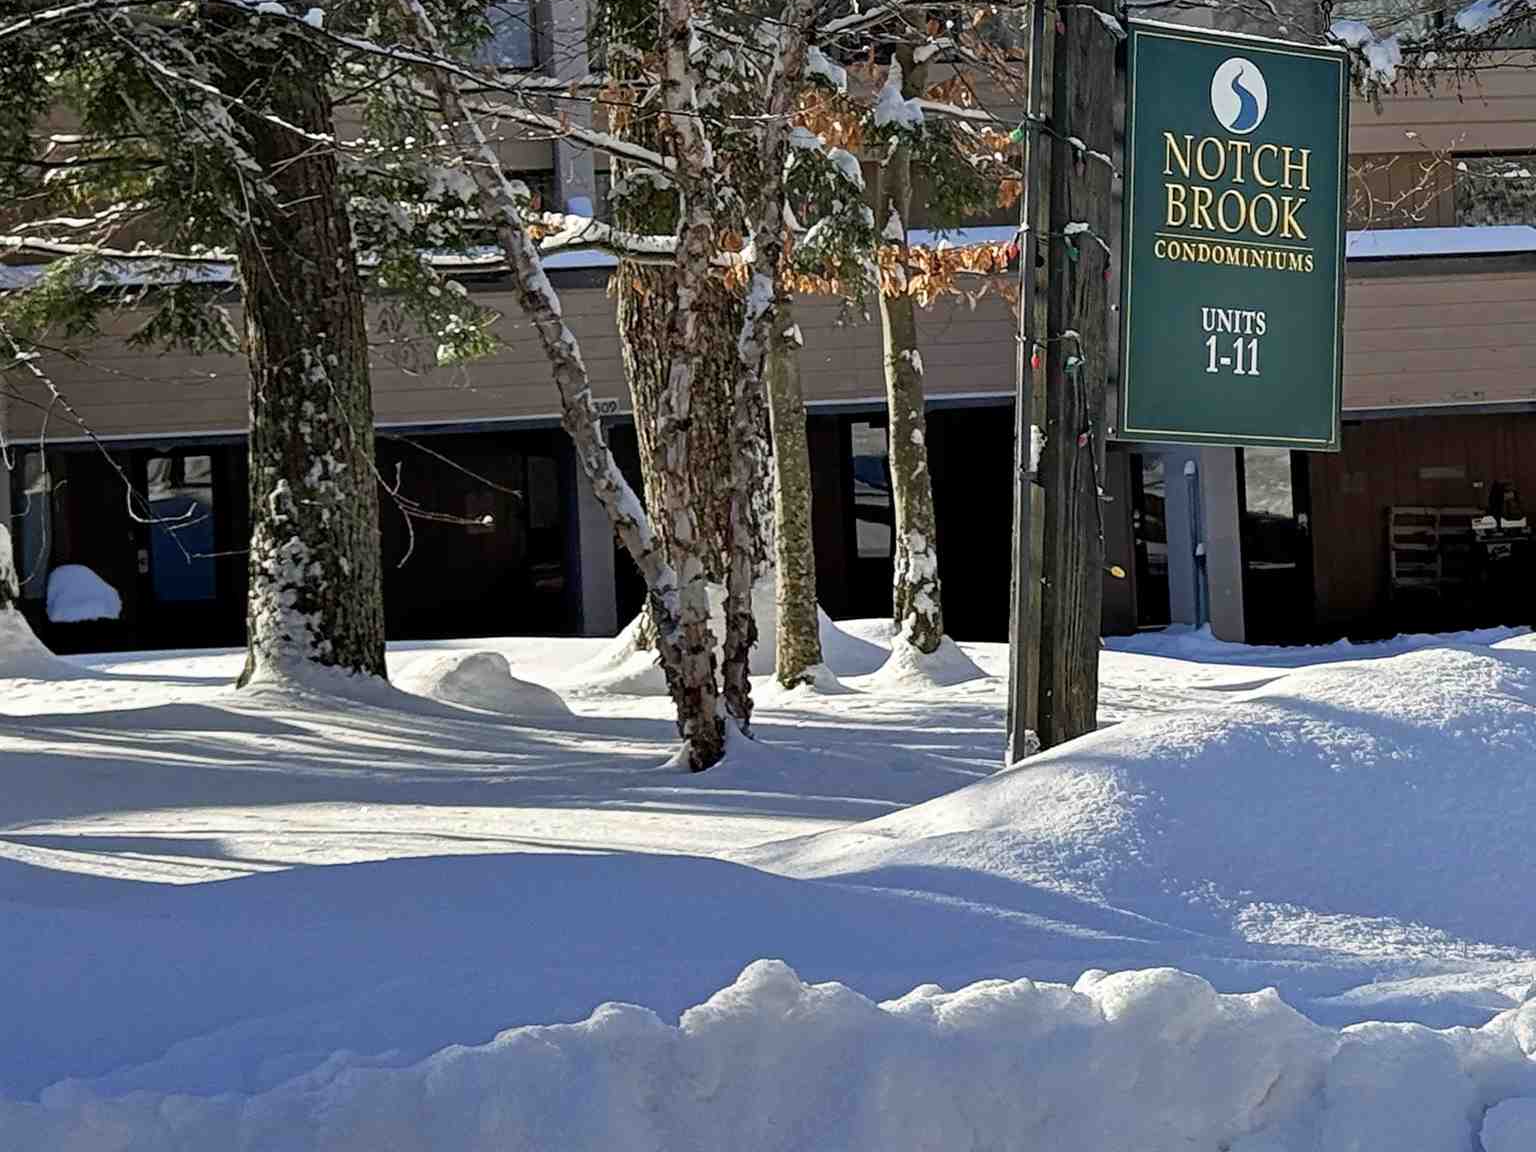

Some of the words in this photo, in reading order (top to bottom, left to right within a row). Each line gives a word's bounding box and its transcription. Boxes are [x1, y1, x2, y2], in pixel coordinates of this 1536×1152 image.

[1162, 131, 1312, 191] NOTCH
[1164, 183, 1307, 240] BROOK
[1154, 239, 1314, 273] CONDOMINIUMS
[1201, 307, 1266, 336] UNITS
[1205, 335, 1260, 375] 1-11
